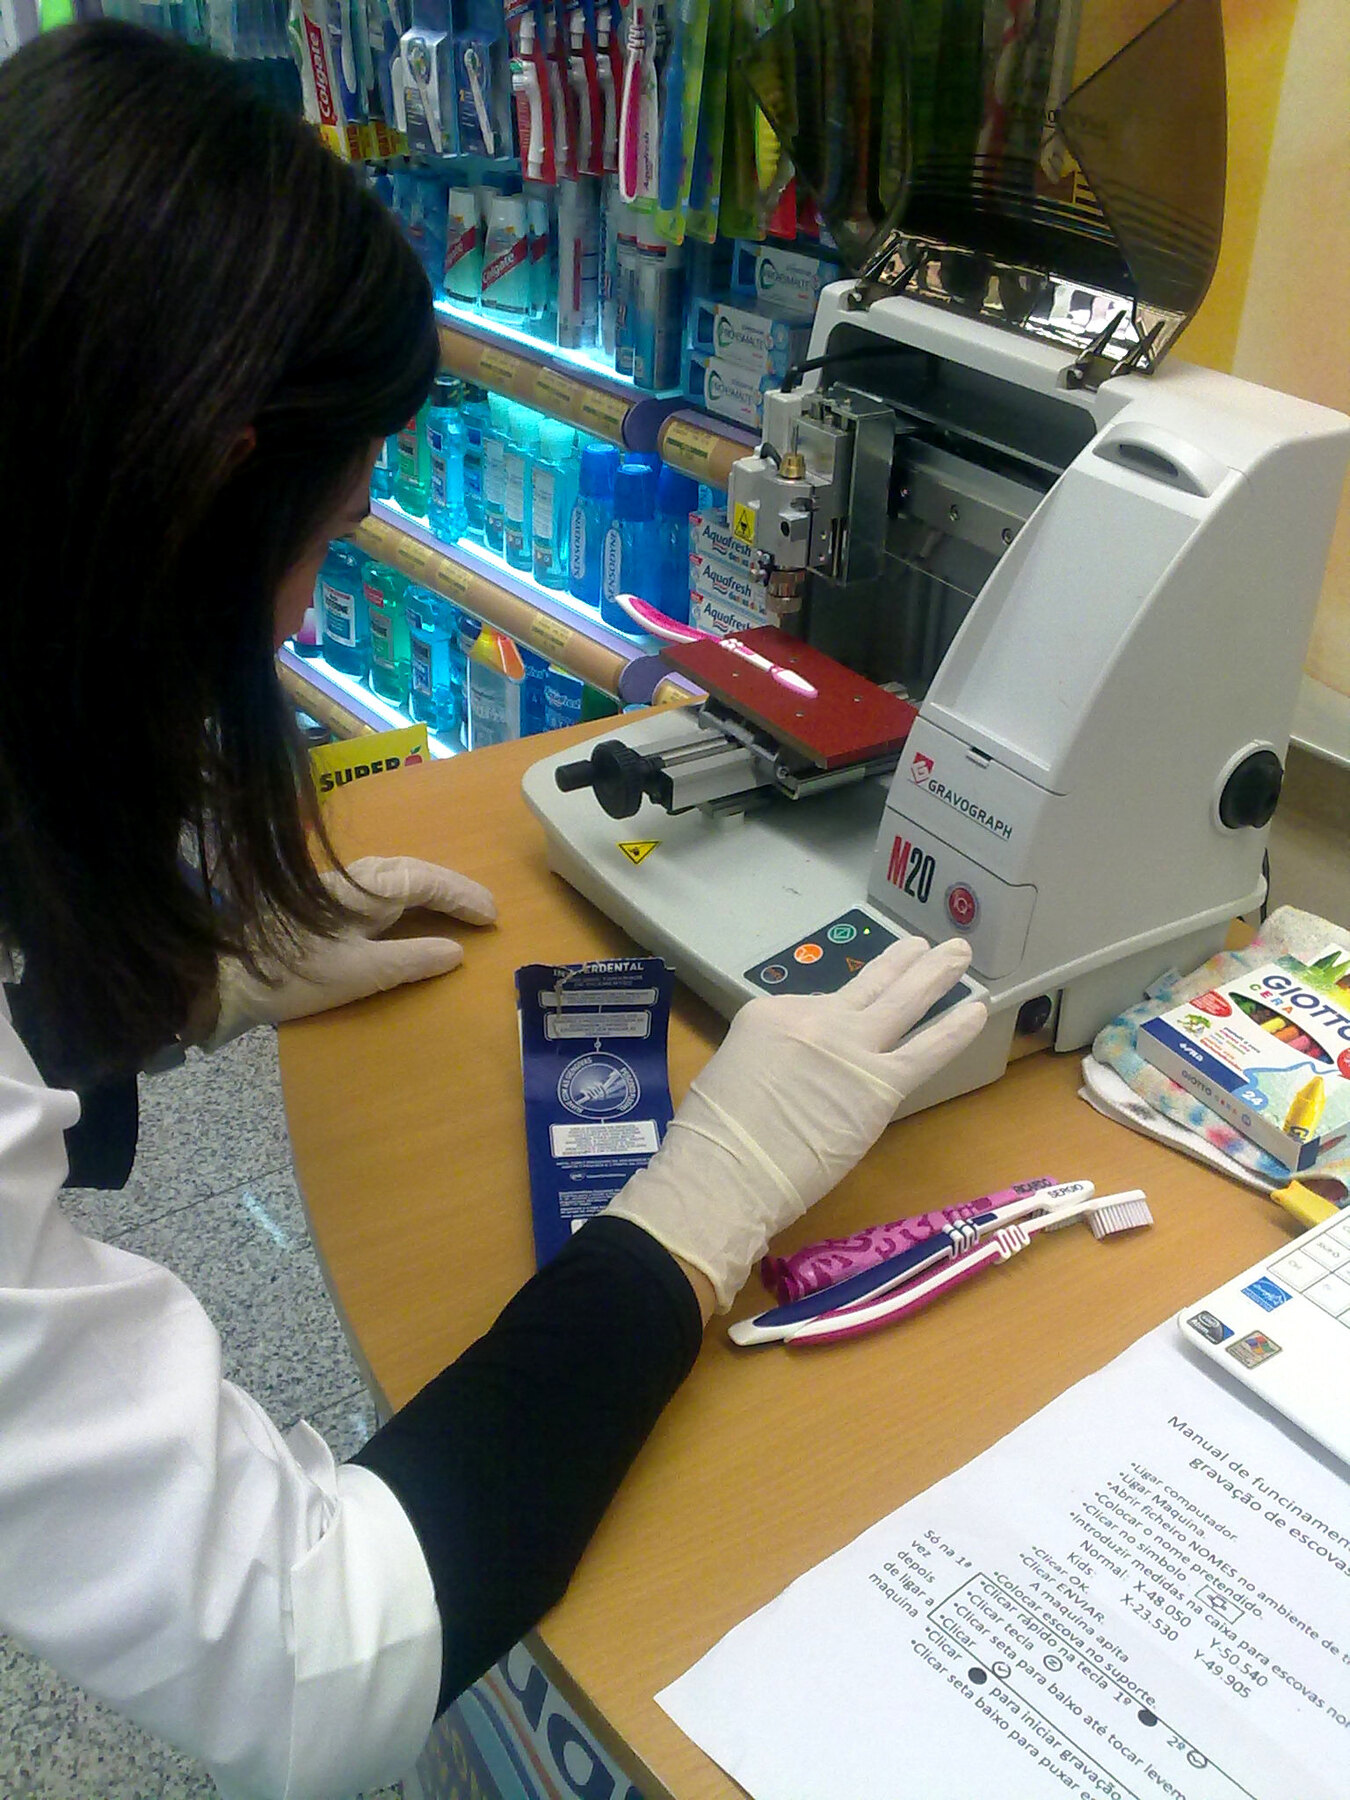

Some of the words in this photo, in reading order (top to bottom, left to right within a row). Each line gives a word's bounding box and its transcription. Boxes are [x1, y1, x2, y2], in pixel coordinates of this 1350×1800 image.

[702, 525, 752, 557] Aquafresh
[702, 565, 752, 597] Aquafresh
[928, 779, 1013, 840] GRAVOGRAPH
[887, 834, 936, 904] M20
[1249, 984, 1293, 1015] CERA
[1242, 1090, 1264, 1107] 24
[1133, 1464, 1164, 1486] Ligar
[1167, 1415, 1230, 1461] Manual
[1228, 1461, 1250, 1479] de
[1121, 1474, 1152, 1496] Ligar
[1188, 1458, 1262, 1512] gravação
[1264, 1511, 1286, 1528] de
[911, 1540, 932, 1559] vez
[924, 1529, 941, 1544] Só
[939, 1542, 955, 1557] na
[1085, 1504, 1119, 1530] Clicar
[1119, 1529, 1136, 1544] no
[1097, 1494, 1143, 1528] Colocar
[1143, 1527, 1153, 1536] o
[1153, 1535, 1191, 1565] nome
[883, 1561, 899, 1577] de
[899, 1573, 926, 1598] ligar
[925, 1597, 935, 1607] a
[897, 1550, 936, 1584] depois
[1022, 1555, 1056, 1583] Clicar
[1034, 1548, 1069, 1576] Clicar
[1109, 1484, 1141, 1506] Abrir
[1141, 1505, 1187, 1542] ficheiro
[1188, 1540, 1238, 1578] NOMES
[1237, 1577, 1256, 1592] no
[1257, 1591, 1319, 1640] ambiente
[1321, 1639, 1340, 1656] de
[868, 1573, 919, 1618] maquina
[969, 1594, 1005, 1623] Clicar
[1004, 1623, 1034, 1651] tecla
[997, 1574, 1043, 1612] Colocar
[1042, 1612, 1085, 1648] escova
[1085, 1647, 1104, 1663] no
[1029, 1582, 1041, 1592] A
[1041, 1590, 1095, 1636] maquina
[1096, 1635, 1130, 1663] apita
[1073, 1513, 1132, 1559] Introduzir
[1131, 1558, 1185, 1600] medidas
[1186, 1599, 1203, 1615] na
[1204, 1613, 1238, 1642] caixa
[1237, 1640, 1270, 1666] para
[1271, 1664, 1325, 1708] escovas
[942, 1617, 977, 1648] Clicar
[983, 1582, 1018, 1613] Clicar
[1057, 1645, 1076, 1663] na
[1076, 1660, 1109, 1690] tecla
[1120, 1593, 1179, 1641] X-23.530
[1193, 1649, 1251, 1698] Y-49.905
[1133, 1580, 1192, 1627] X-48.050
[1210, 1637, 1269, 1687] Y-50.540
[956, 1605, 991, 1635] Clicar
[990, 1635, 1017, 1660] seta
[1016, 1659, 1047, 1685] para
[1047, 1683, 1082, 1716] baixo
[1083, 1715, 1108, 1736] até
[1108, 1733, 1144, 1765] tocar
[913, 1642, 948, 1674] Clicar
[947, 1674, 974, 1699] seta
[975, 1696, 1009, 1730] baixo
[1007, 1729, 1040, 1757] para
[1038, 1756, 1080, 1790] puxar
[927, 1629, 963, 1661] Clicar
[989, 1686, 1021, 1714] para
[1020, 1711, 1062, 1749] iniciar
[1059, 1749, 1121, 1800] gravação
